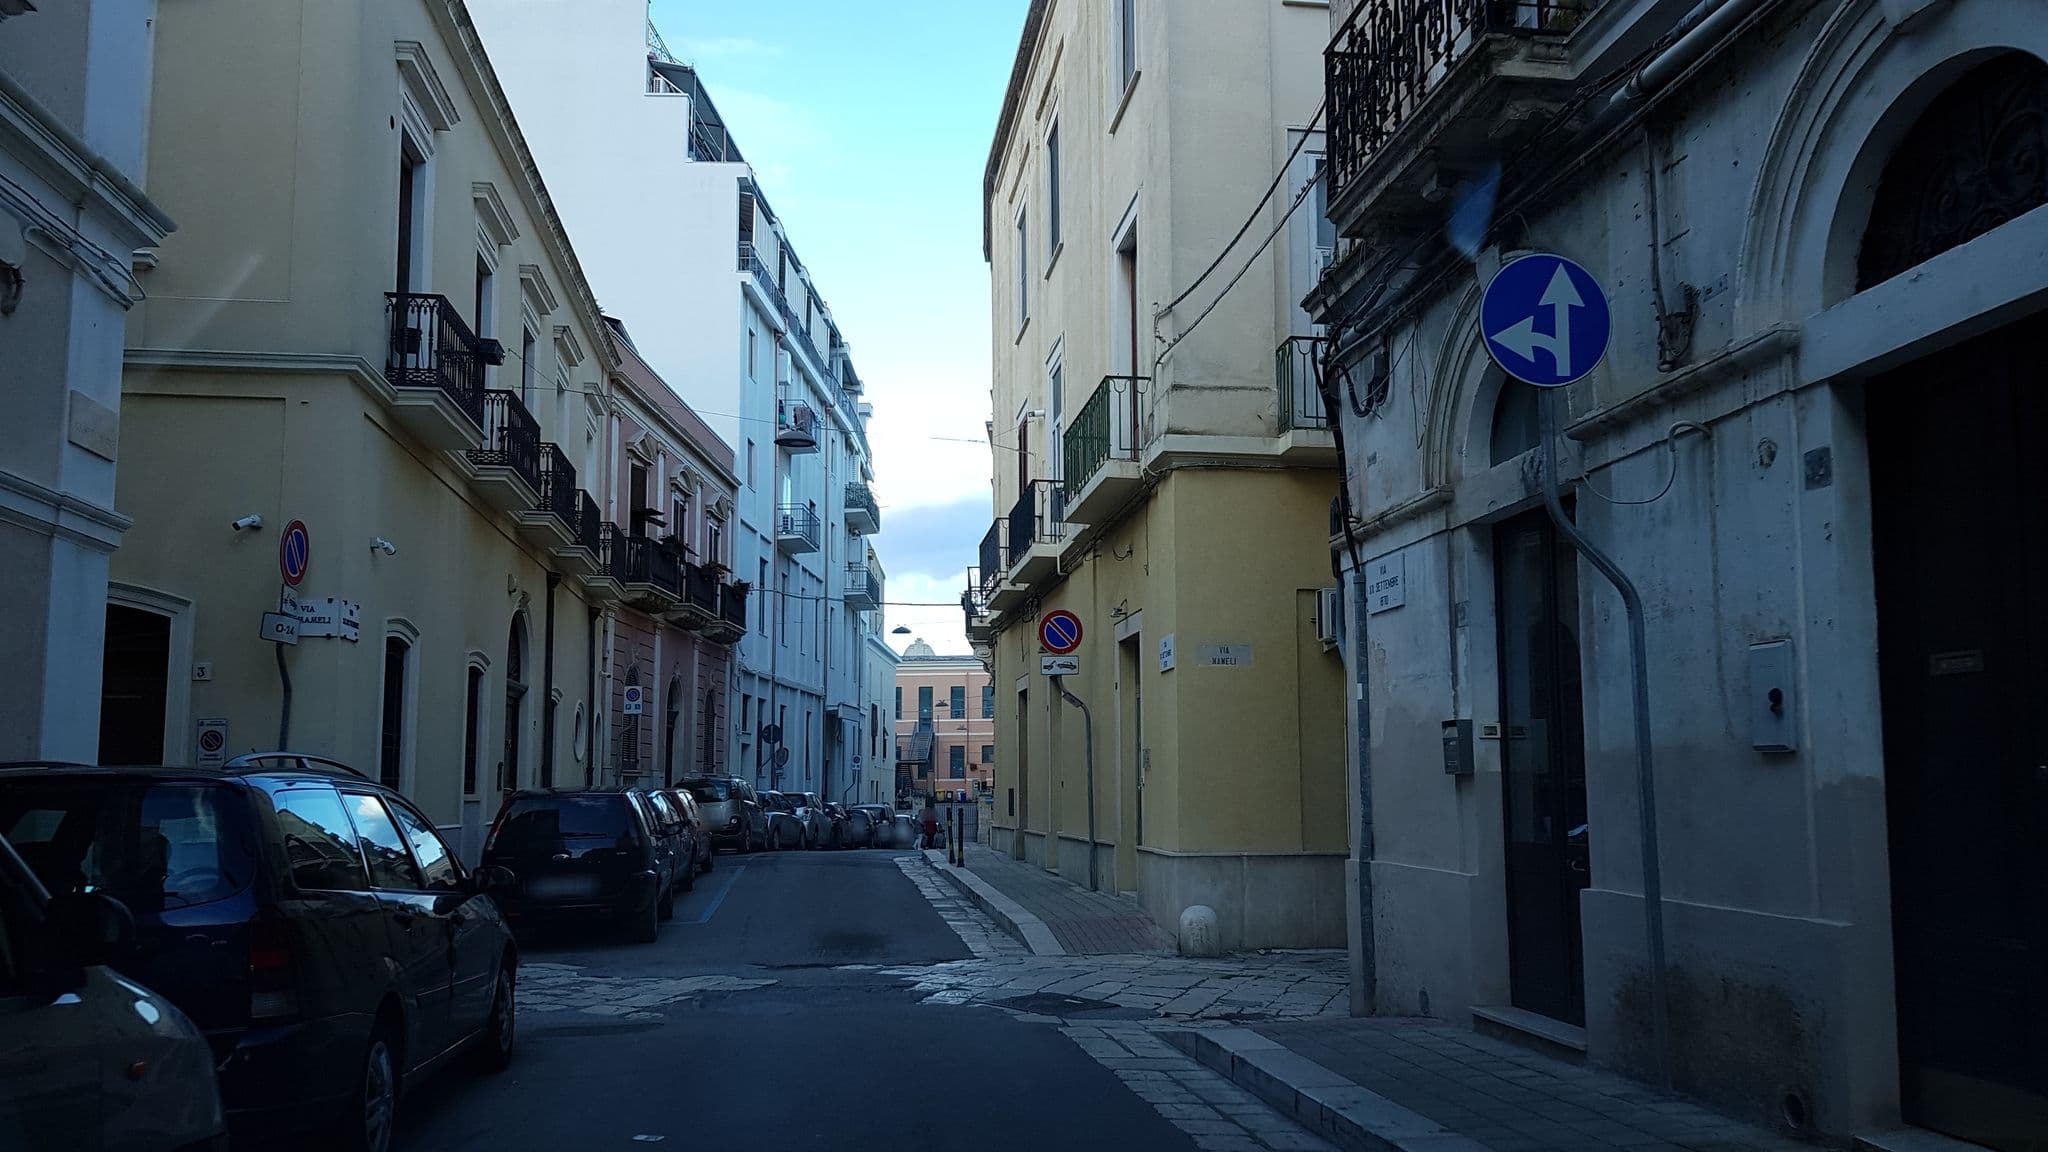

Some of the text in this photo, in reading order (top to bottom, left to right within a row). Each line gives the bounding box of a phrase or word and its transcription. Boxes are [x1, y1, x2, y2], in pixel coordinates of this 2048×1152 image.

[300, 605, 315, 613] VIA
[1219, 646, 1230, 654] VIA
[197, 666, 205, 678] 3
